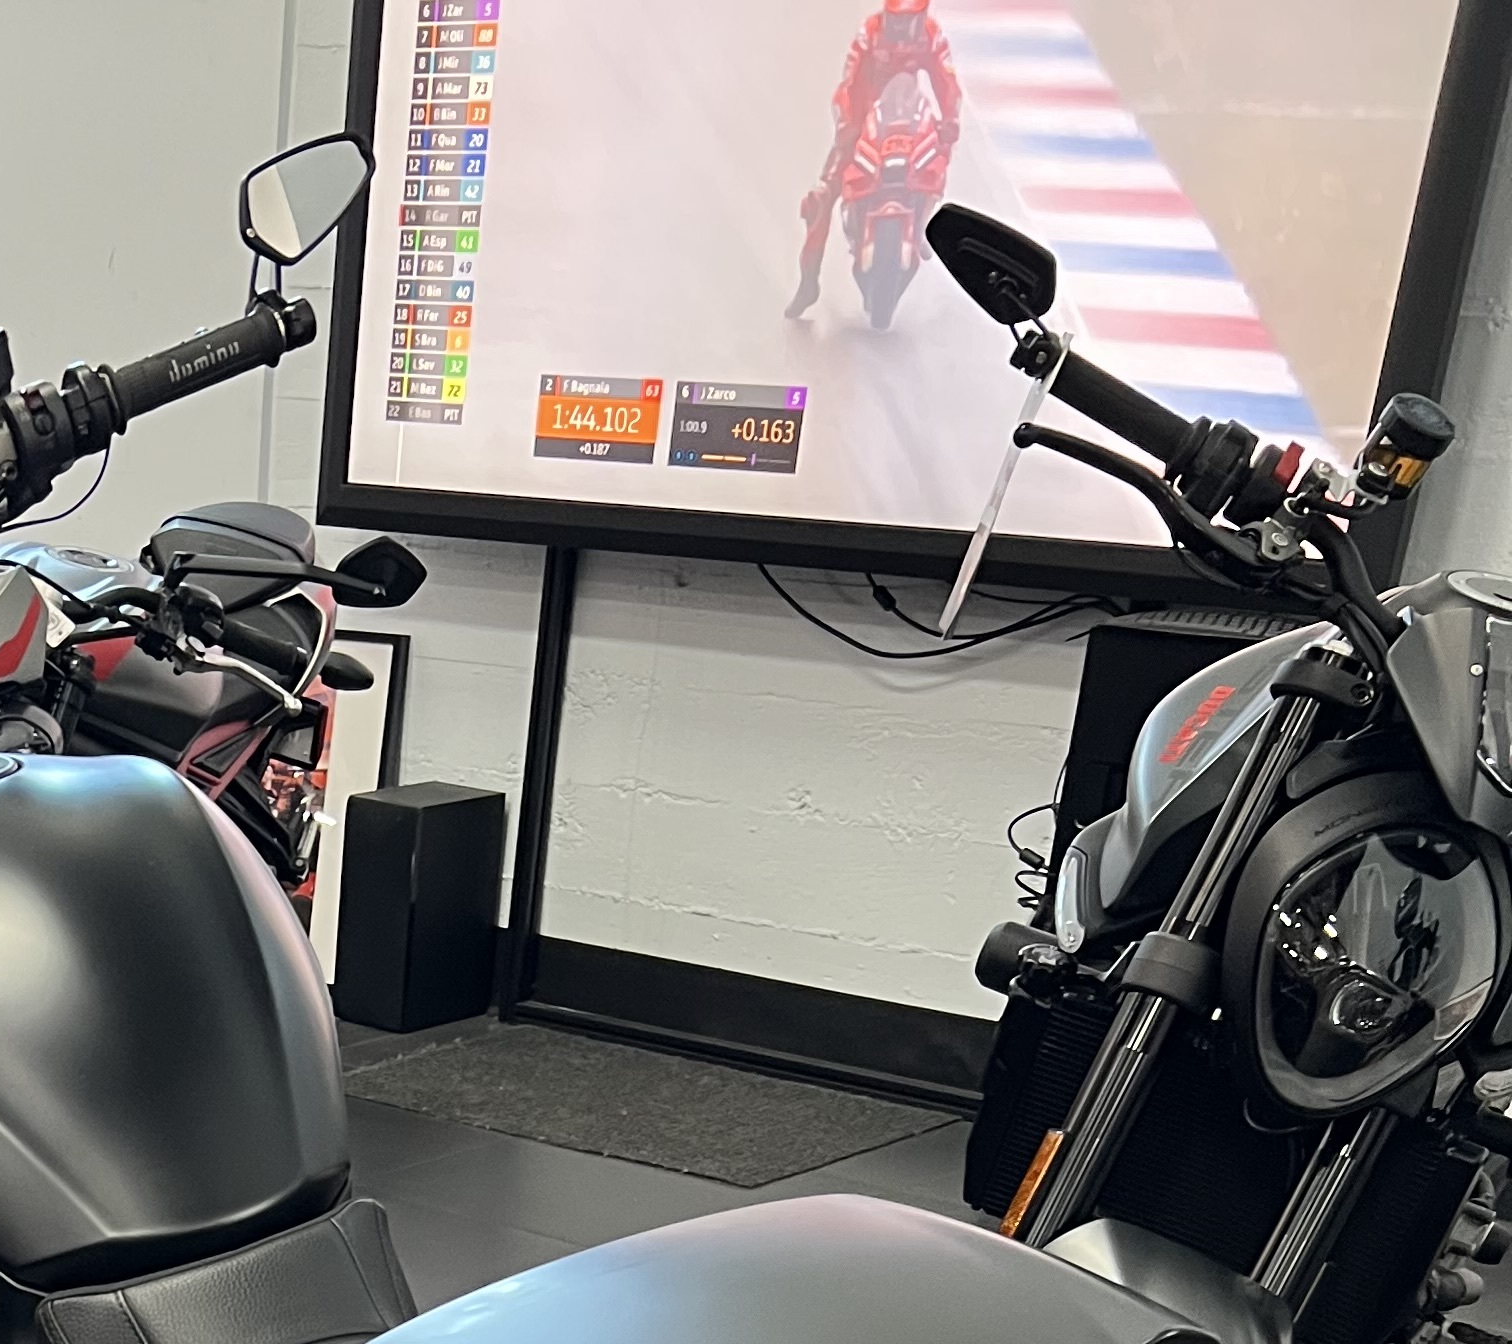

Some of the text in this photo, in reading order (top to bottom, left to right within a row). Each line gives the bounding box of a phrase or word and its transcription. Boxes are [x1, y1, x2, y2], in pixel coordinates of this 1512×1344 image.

[422, 4, 430, 18] 6
[447, 4, 464, 17] Zar
[484, 2, 492, 16] 5
[421, 30, 428, 44] 7
[418, 56, 426, 70] 8
[443, 56, 459, 69] Mir
[476, 55, 491, 69] 36
[416, 81, 488, 95] 9 A Mar 73
[412, 108, 425, 121] 10
[472, 108, 486, 121] 33
[411, 133, 422, 147] 11
[438, 134, 456, 148] Qua
[469, 134, 484, 148] 20
[408, 159, 421, 172] 12
[467, 159, 481, 173] 21
[407, 184, 480, 198] 13 A Rin 42
[405, 209, 416, 222] 14
[462, 210, 478, 224] PIT
[402, 234, 474, 250] 15 A Esp 41
[400, 259, 412, 272] 16
[427, 260, 444, 272] DiG
[458, 261, 472, 274] 49
[398, 284, 410, 296] 17
[426, 284, 442, 297] Bin
[456, 286, 471, 299] 40
[396, 308, 408, 320] 18
[424, 310, 439, 322] Fer
[454, 311, 468, 324] 25
[394, 333, 406, 345] 19
[414, 333, 420, 346] S
[421, 334, 437, 346] Bra
[392, 357, 404, 369] 20
[418, 358, 435, 371] Sav
[450, 360, 464, 373] 32
[390, 381, 401, 393] 21
[420, 383, 437, 395] Bez
[448, 384, 462, 397] 72
[545, 378, 553, 391] 2
[645, 384, 660, 398] 63
[681, 385, 689, 398] 6
[706, 386, 736, 401] Zarco
[791, 391, 801, 405] 5
[388, 405, 400, 417] 22
[444, 408, 460, 421] PIT
[552, 403, 641, 434] 1:44.102
[731, 418, 795, 444] +0.163
[579, 442, 610, 456] +0.187
